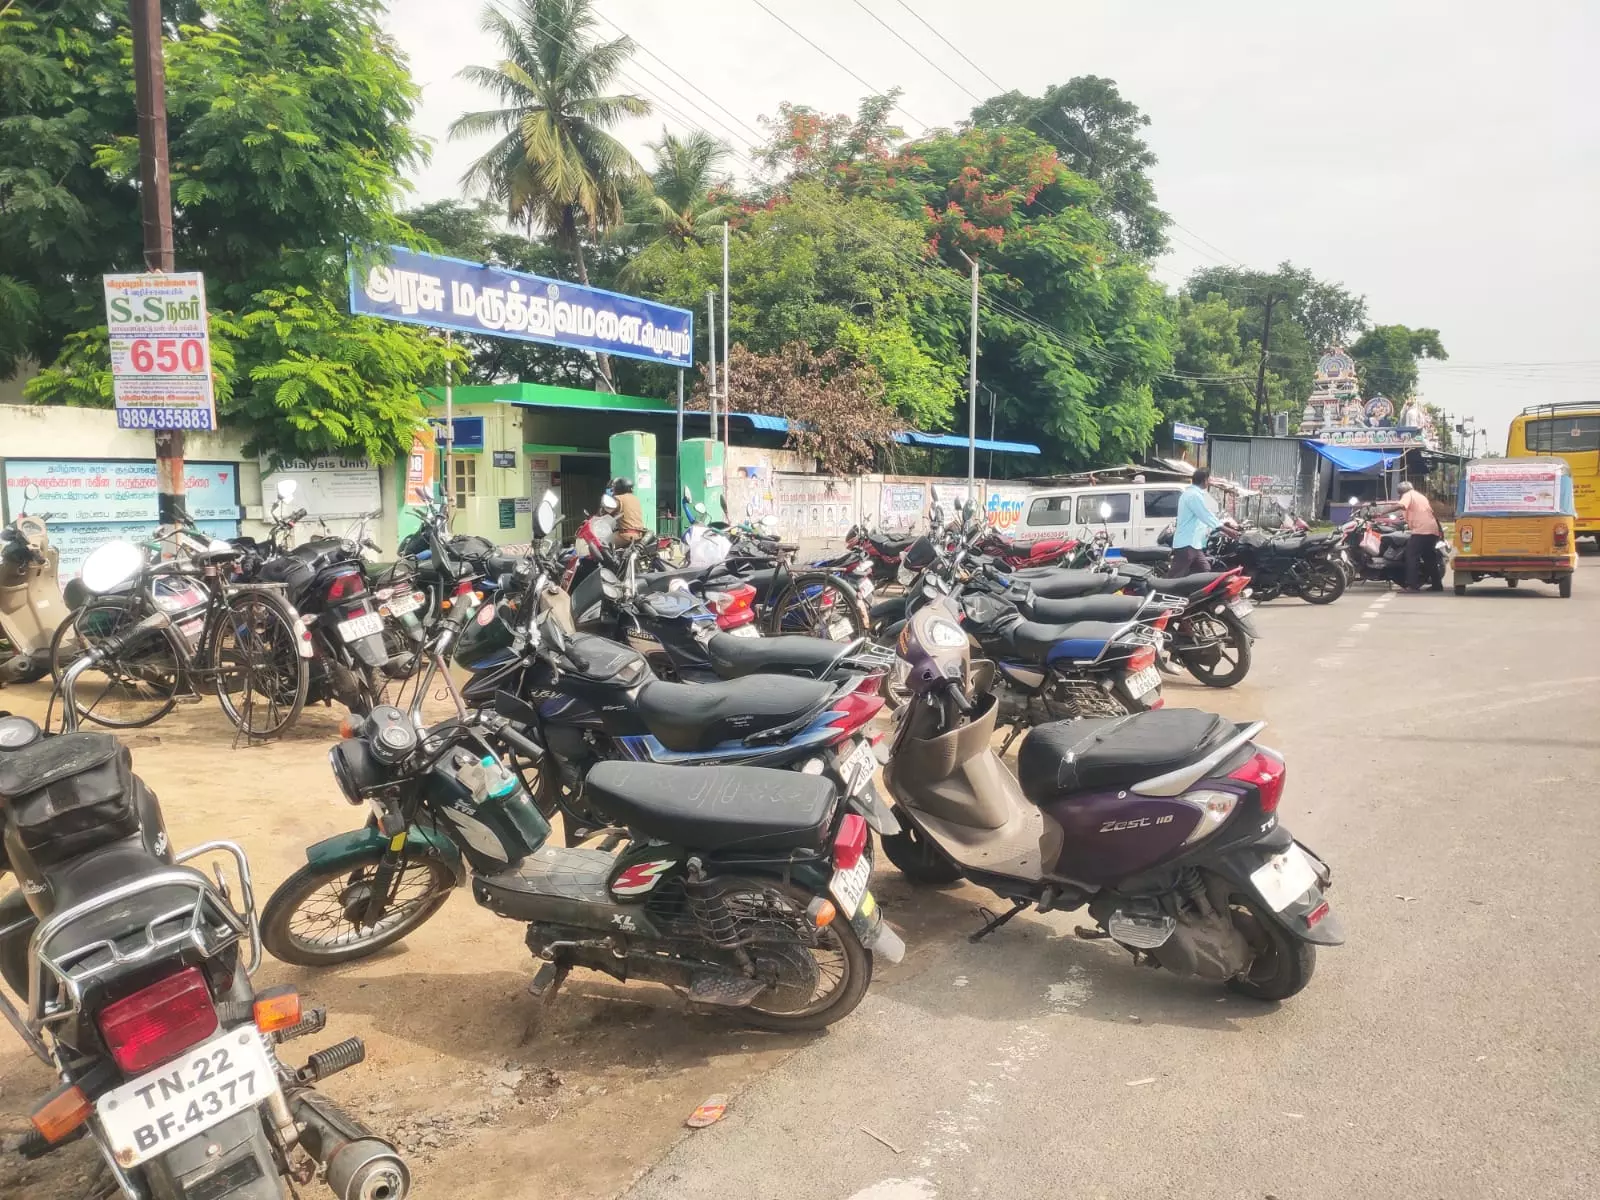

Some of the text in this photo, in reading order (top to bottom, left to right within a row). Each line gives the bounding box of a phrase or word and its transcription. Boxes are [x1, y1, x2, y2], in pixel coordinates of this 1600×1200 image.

[365, 264, 445, 315] அரசு
[131, 339, 204, 373] 650
[123, 409, 209, 428] 9894355883
[339, 458, 369, 470] Unit)
[1099, 814, 1174, 833] Zest 110
[611, 914, 635, 926] XL
[133, 1047, 234, 1111] TN.22
[132, 1070, 258, 1152] BF.4377
